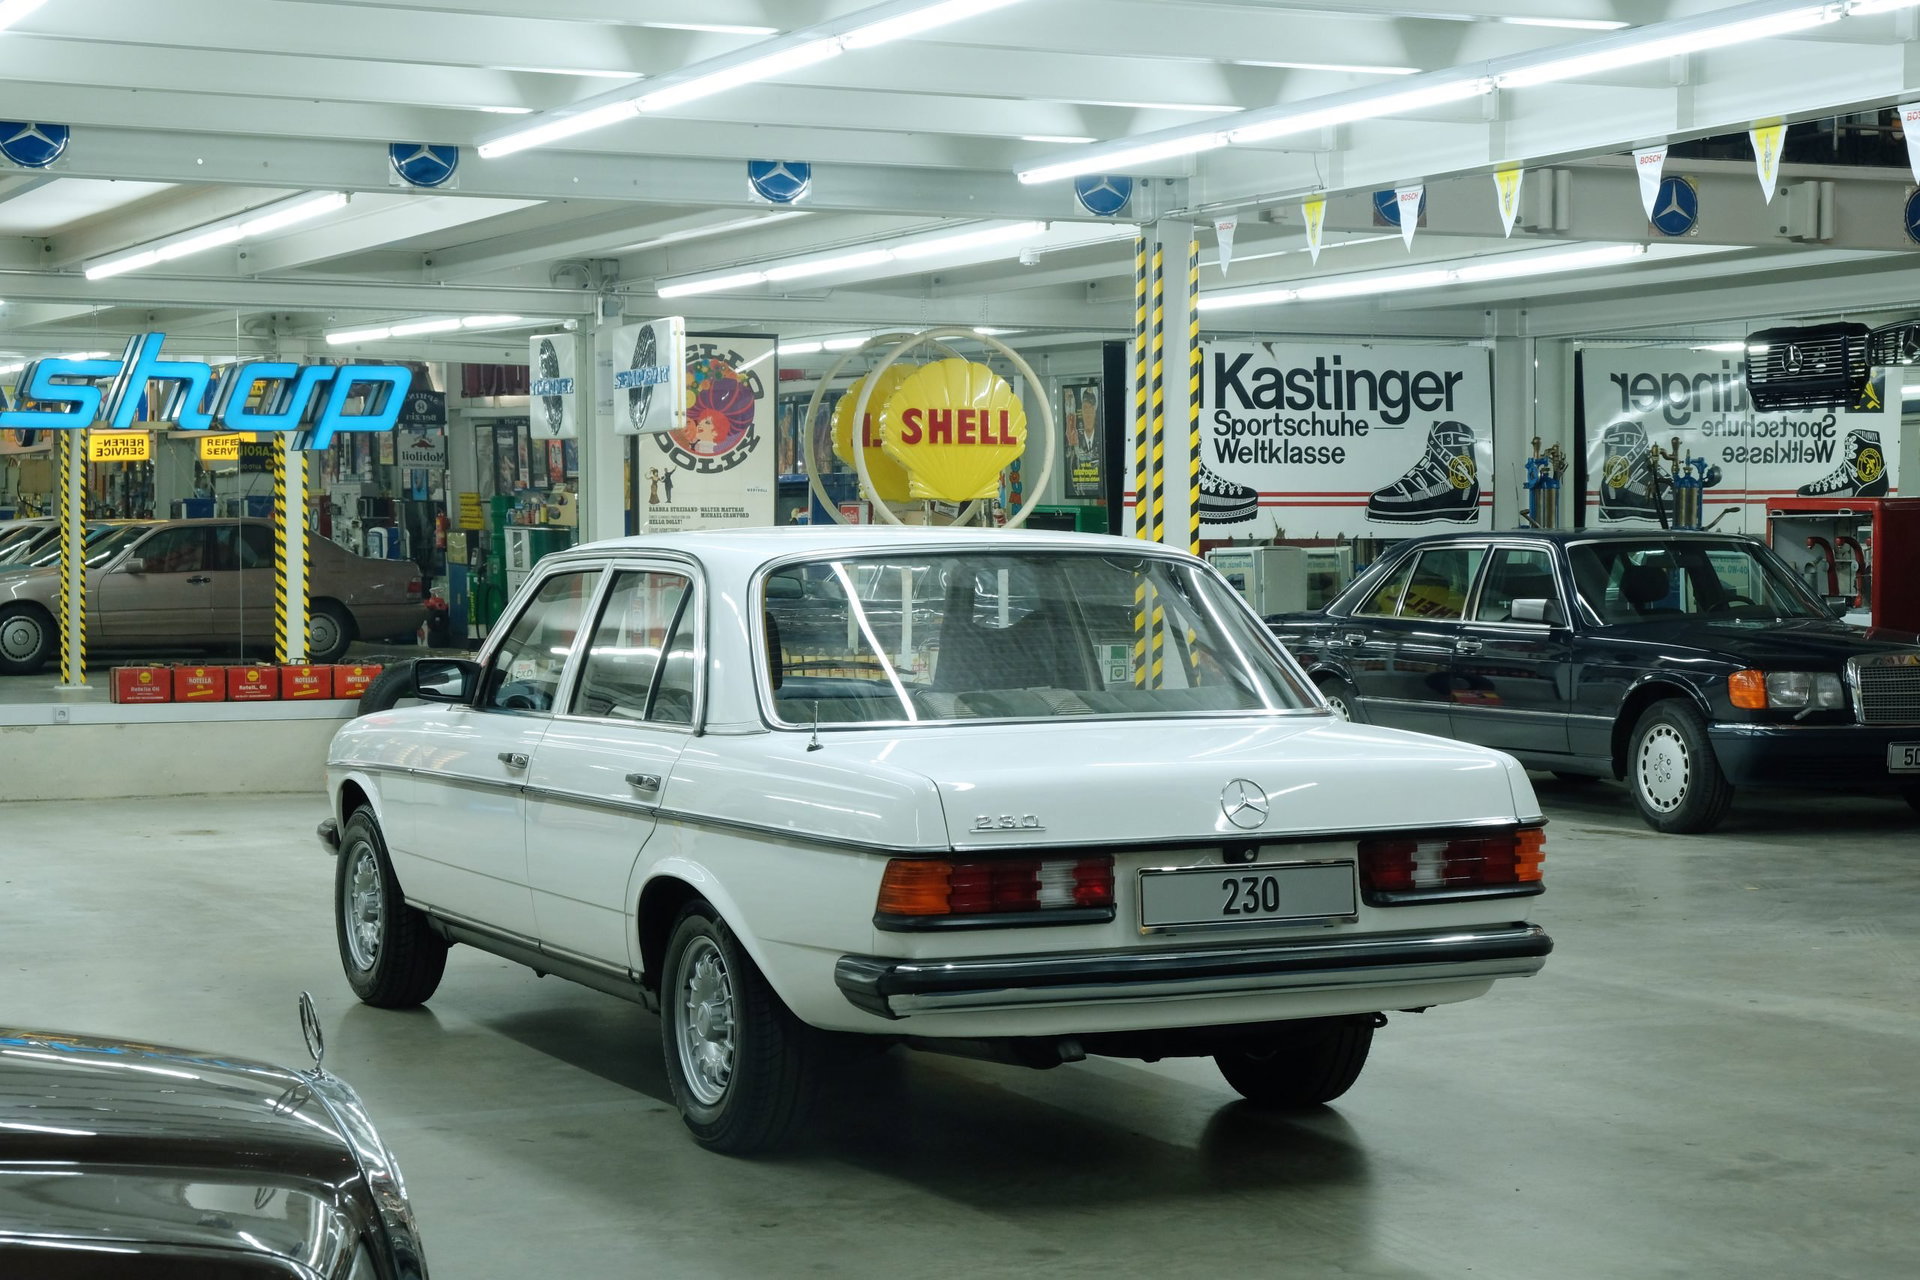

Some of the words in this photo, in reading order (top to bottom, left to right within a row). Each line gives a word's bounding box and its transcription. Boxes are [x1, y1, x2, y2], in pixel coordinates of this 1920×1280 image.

[1640, 154, 1662, 165] BOSCH
[1400, 192, 1419, 202] BOSCH
[615, 365, 670, 390] SEMPERIT
[685, 343, 765, 400] ELLO
[1214, 352, 1464, 425] Kastinger
[0, 332, 413, 451] shop
[901, 407, 1017, 445] SHELL
[1213, 409, 1369, 440] Sportschuhe
[653, 422, 761, 474] DOLLY
[1214, 438, 1346, 464] Weltklasse
[975, 814, 1040, 829] 230
[1222, 875, 1280, 916] 230
